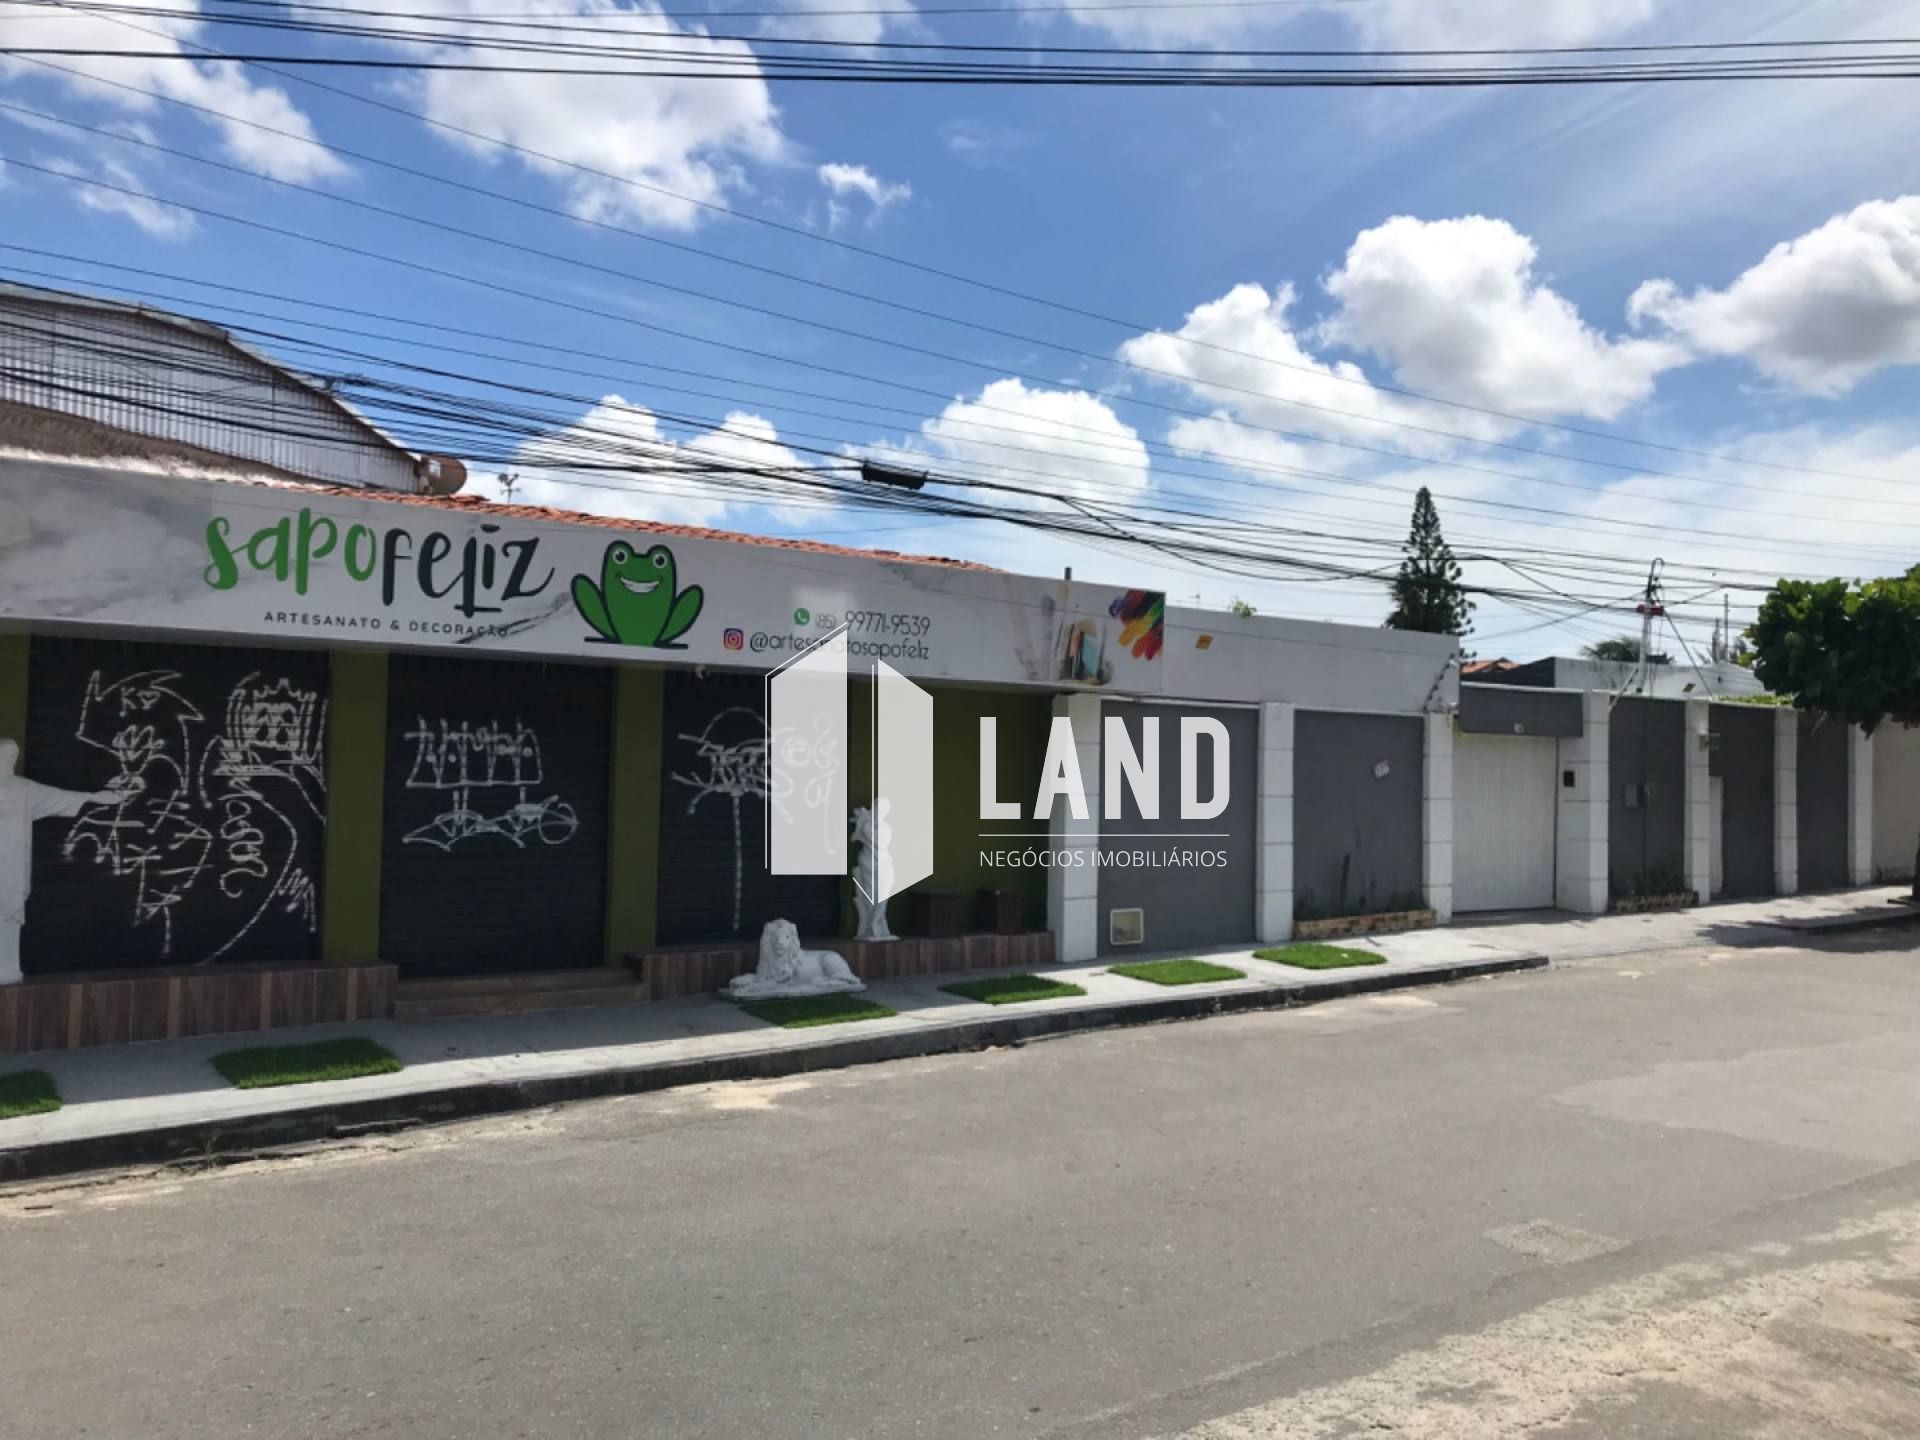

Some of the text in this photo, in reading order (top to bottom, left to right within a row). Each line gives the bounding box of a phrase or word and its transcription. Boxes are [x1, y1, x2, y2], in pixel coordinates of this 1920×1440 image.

[263, 611, 382, 630] ARTESANATO
[389, 620, 400, 632] &
[844, 610, 931, 637] 99771-9539
